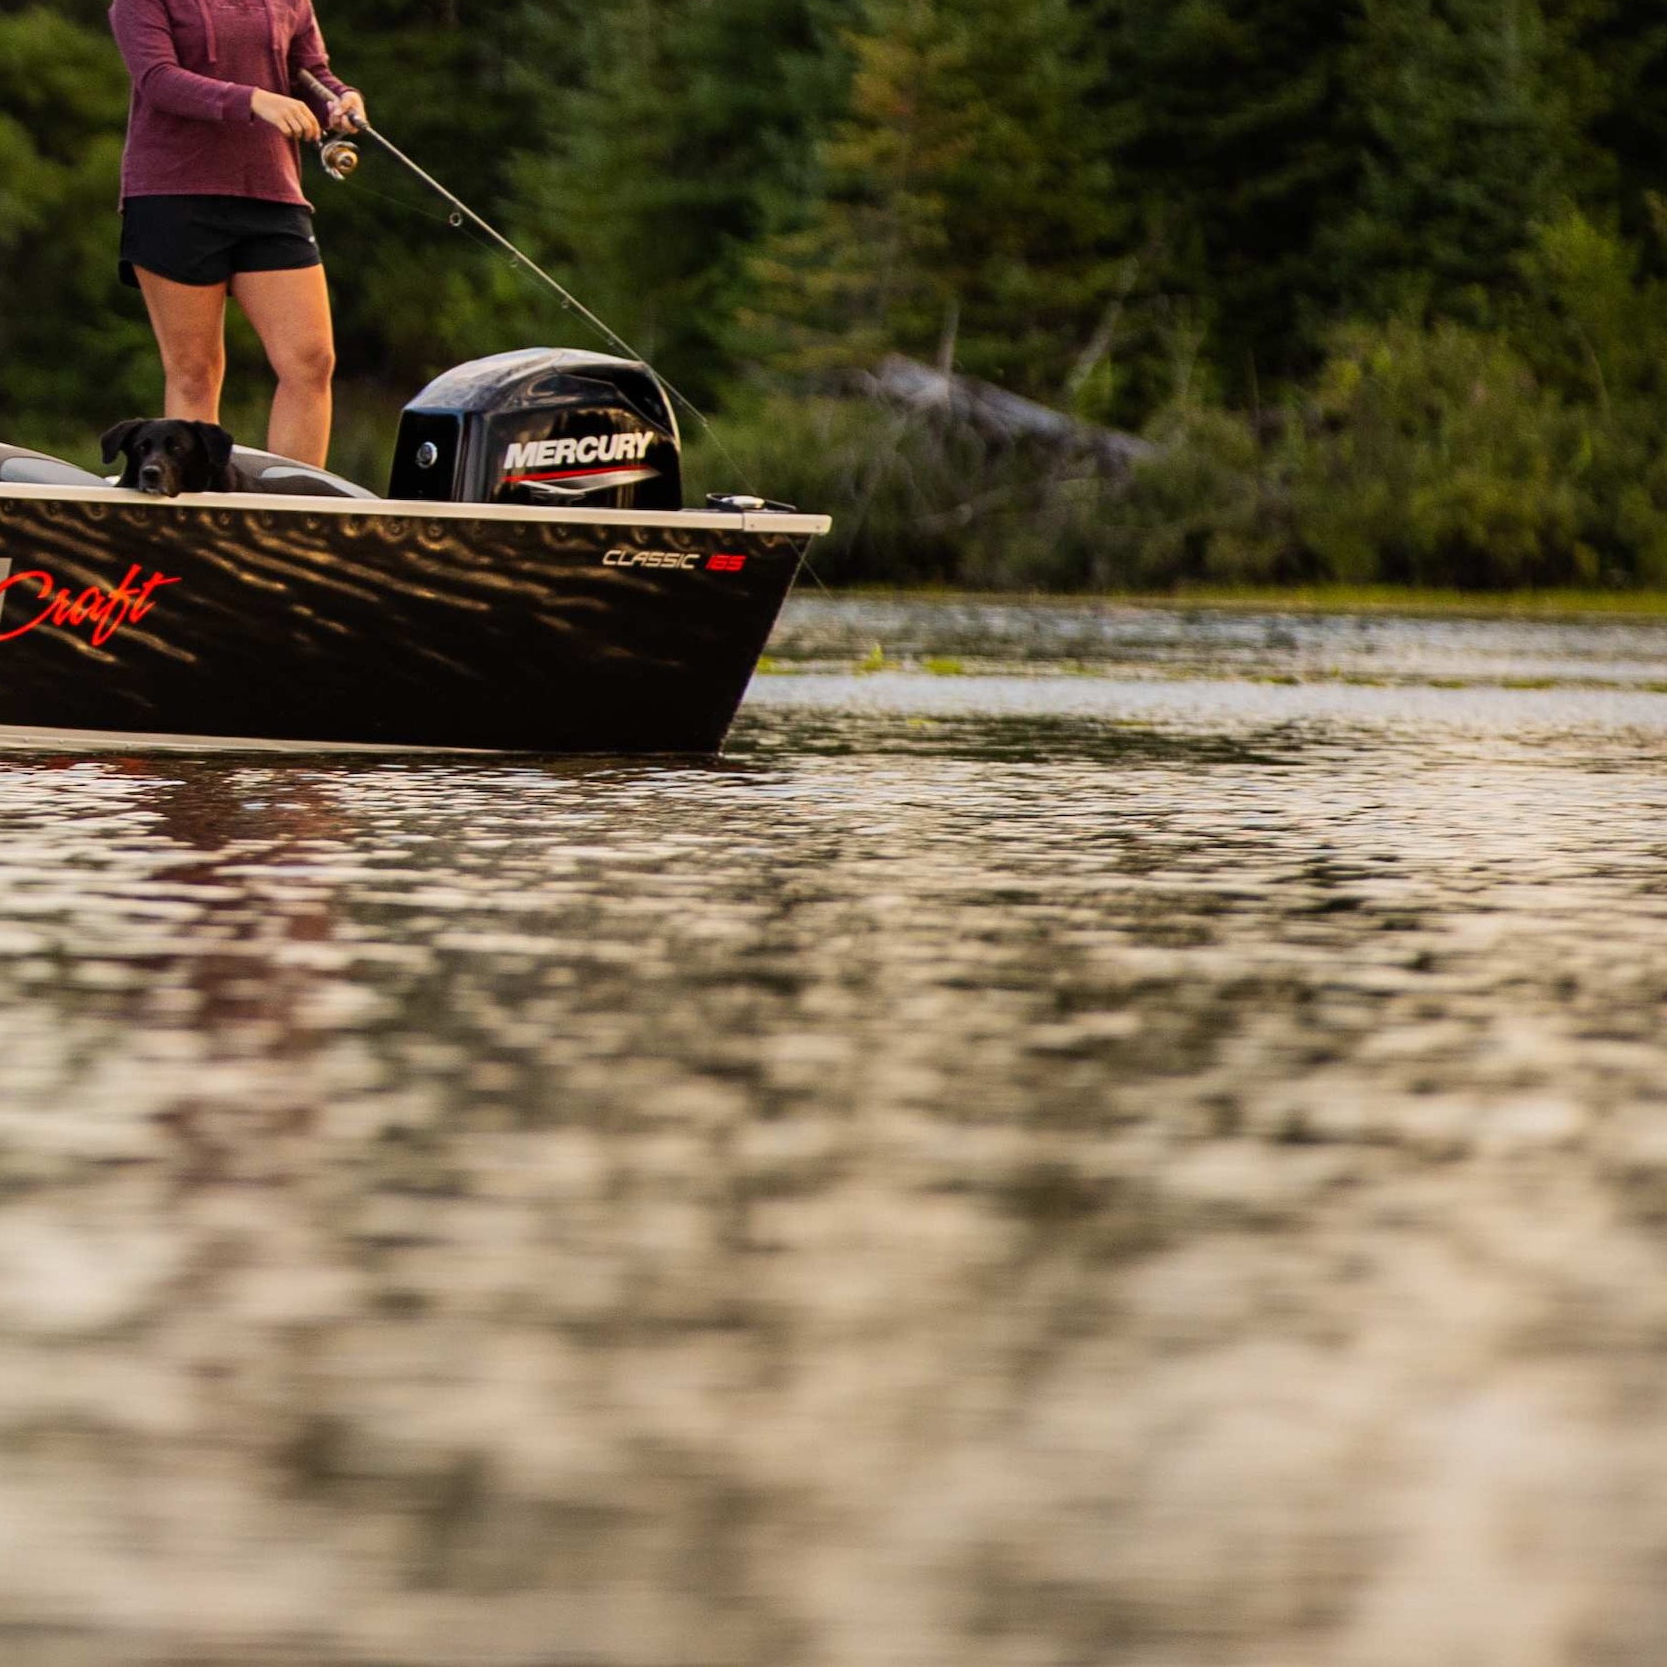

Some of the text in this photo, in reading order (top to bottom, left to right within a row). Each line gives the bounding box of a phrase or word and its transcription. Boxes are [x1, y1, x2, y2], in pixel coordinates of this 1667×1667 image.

[503, 431, 654, 469] MERCURY
[602, 549, 746, 571] CLASSIC 165
